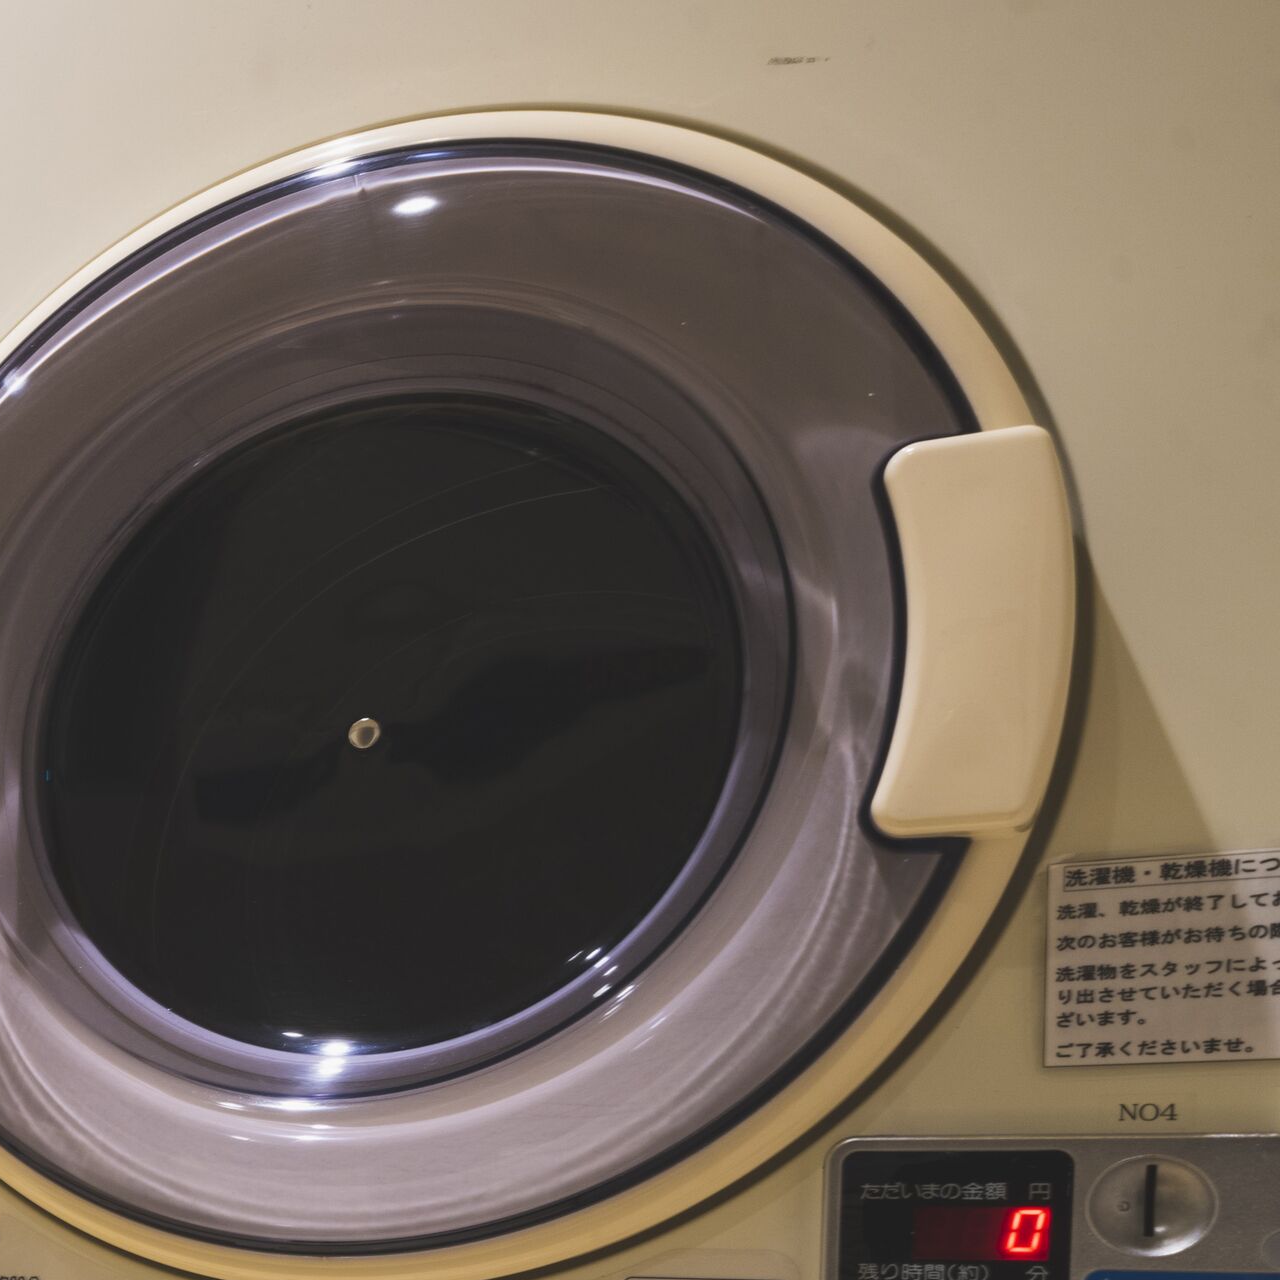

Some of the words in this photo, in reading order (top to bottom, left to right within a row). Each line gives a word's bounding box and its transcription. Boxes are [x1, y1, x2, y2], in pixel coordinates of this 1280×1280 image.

[1056, 1009, 1147, 1028] ざいます。
[1056, 1038, 1254, 1059] ご了承くださいませ。
[1119, 1103, 1178, 1121] NO4
[859, 1182, 1007, 1201] ただいまの金額
[1028, 1184, 1051, 1200] 円
[1004, 1207, 1046, 1254] 0
